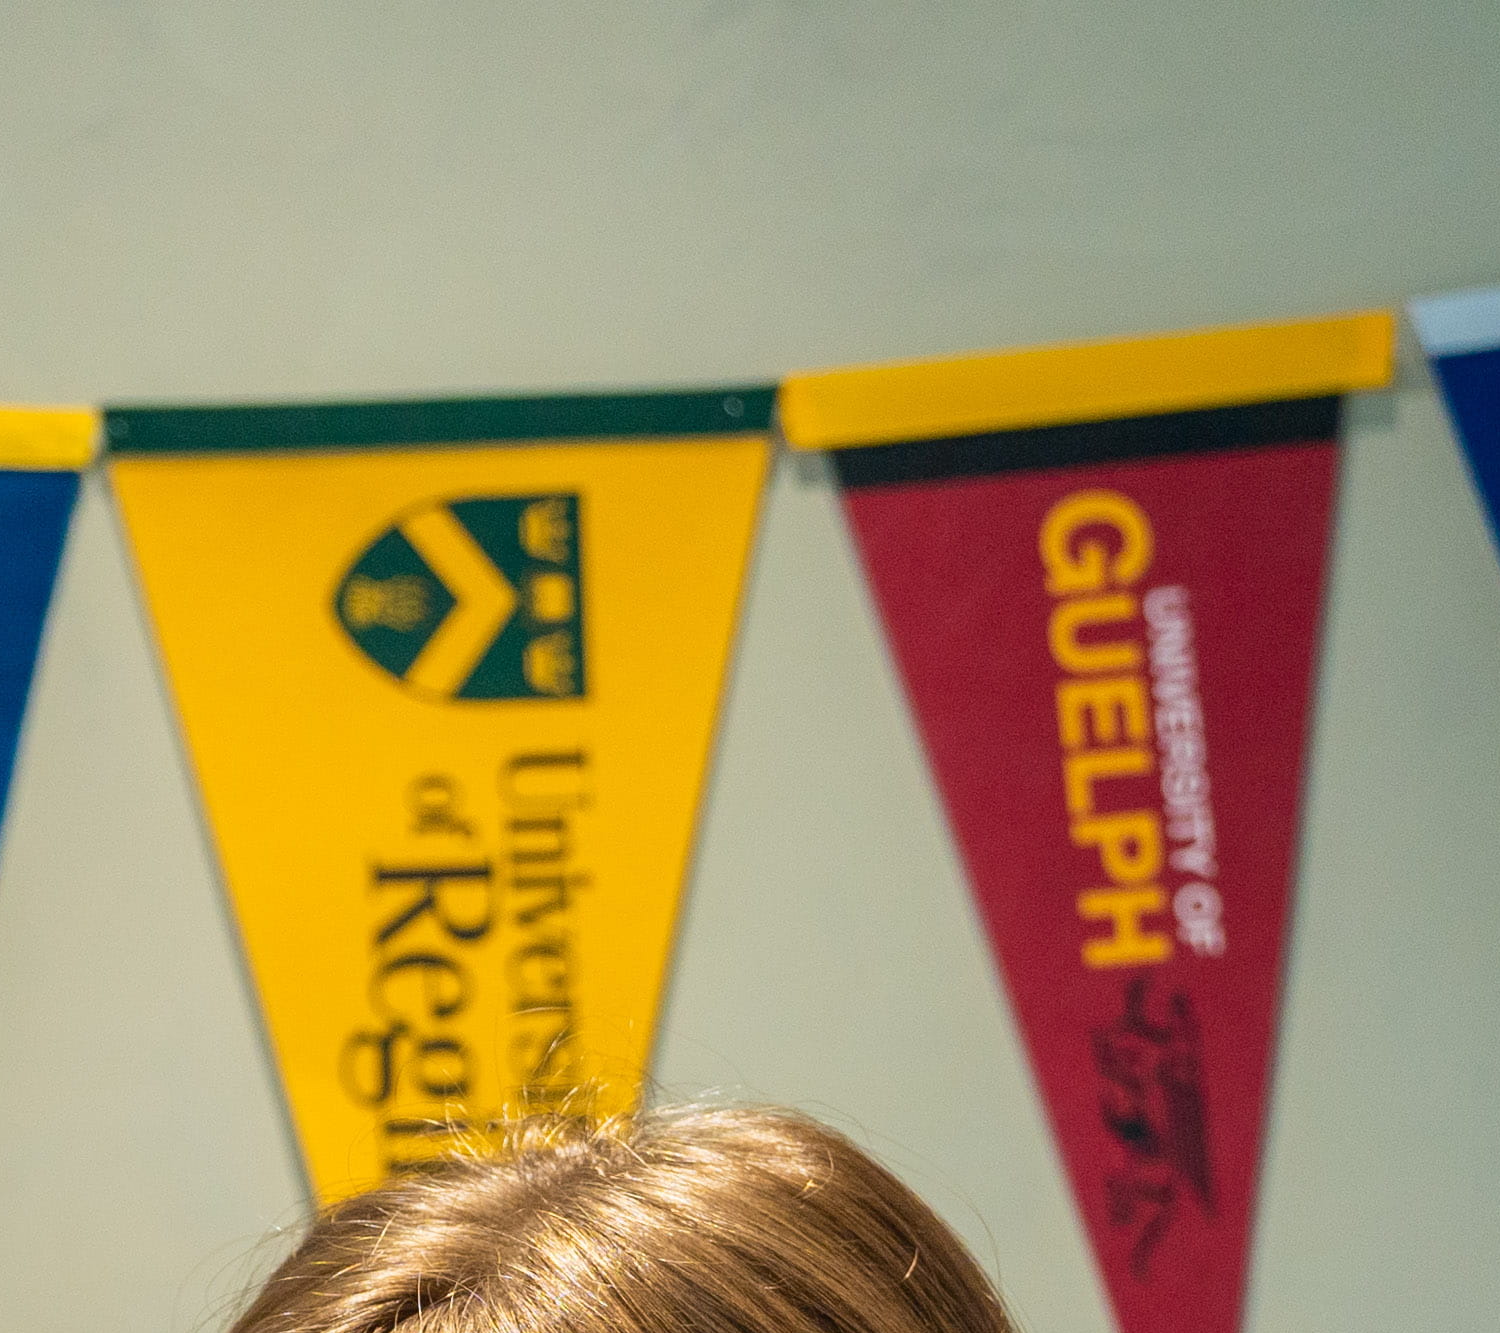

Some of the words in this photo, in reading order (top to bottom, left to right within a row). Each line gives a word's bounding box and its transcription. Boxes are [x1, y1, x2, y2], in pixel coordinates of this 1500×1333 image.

[406, 773, 476, 839] of
[1039, 489, 1174, 970] GUELPH
[1142, 584, 1219, 879] UNIVERSITY
[1172, 881, 1227, 958] OF
